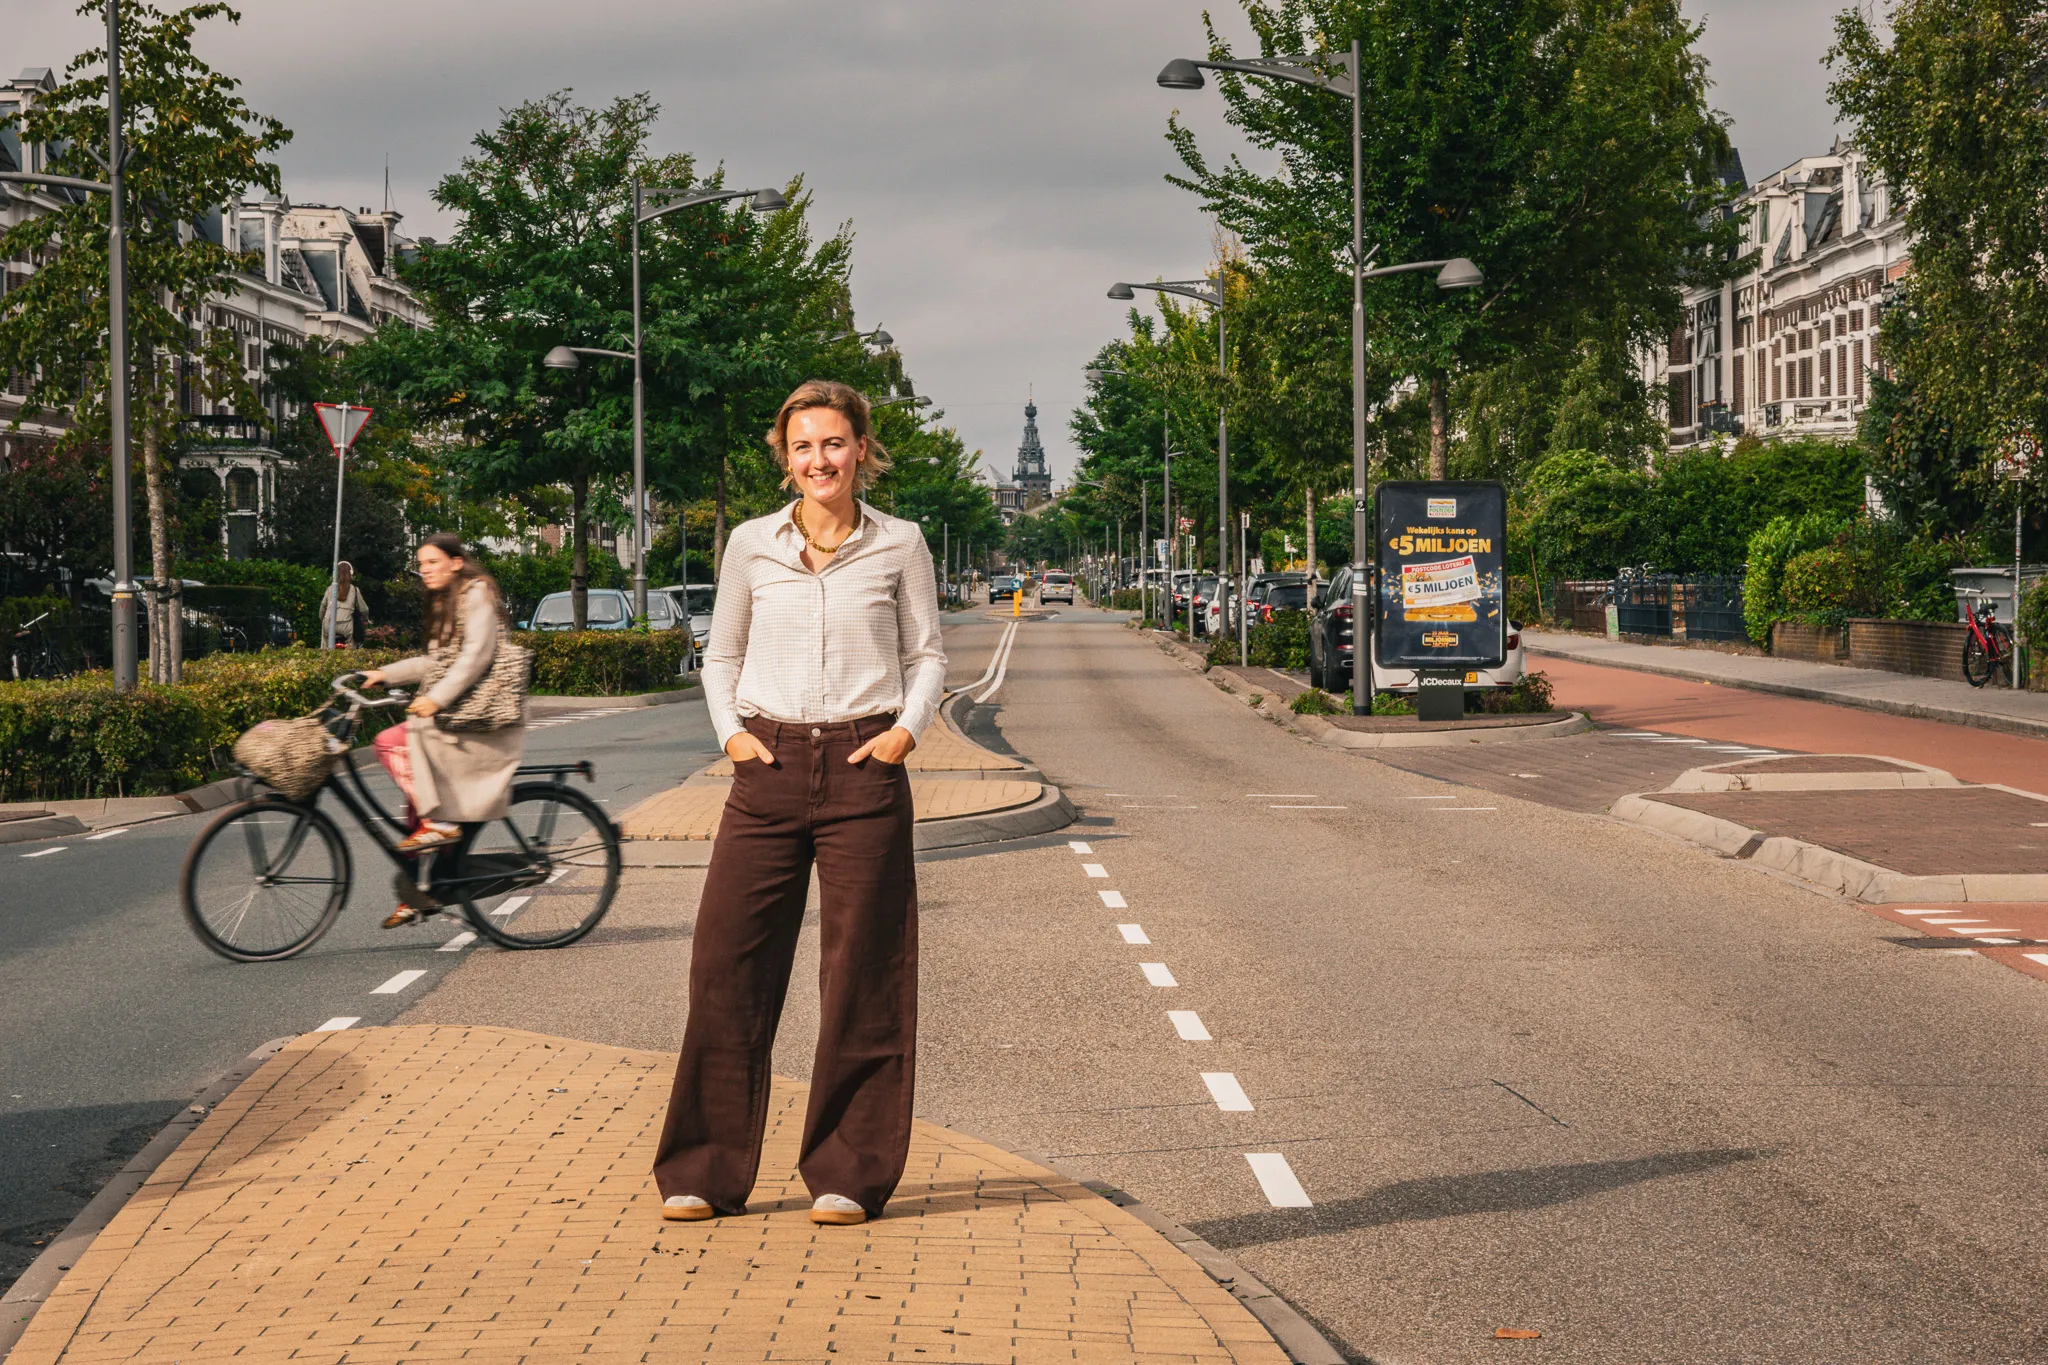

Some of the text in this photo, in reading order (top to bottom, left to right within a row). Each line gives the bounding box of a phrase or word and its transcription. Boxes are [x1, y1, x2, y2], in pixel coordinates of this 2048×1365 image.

[1406, 527, 1445, 535] Wekelijks
[1466, 528, 1477, 536] op
[1389, 535, 1491, 556] €5 MILJOEN
[1442, 561, 1464, 569] LOTERIJ
[1424, 576, 1473, 593] MILJOEN
[1420, 678, 1462, 686] JCDecaux
